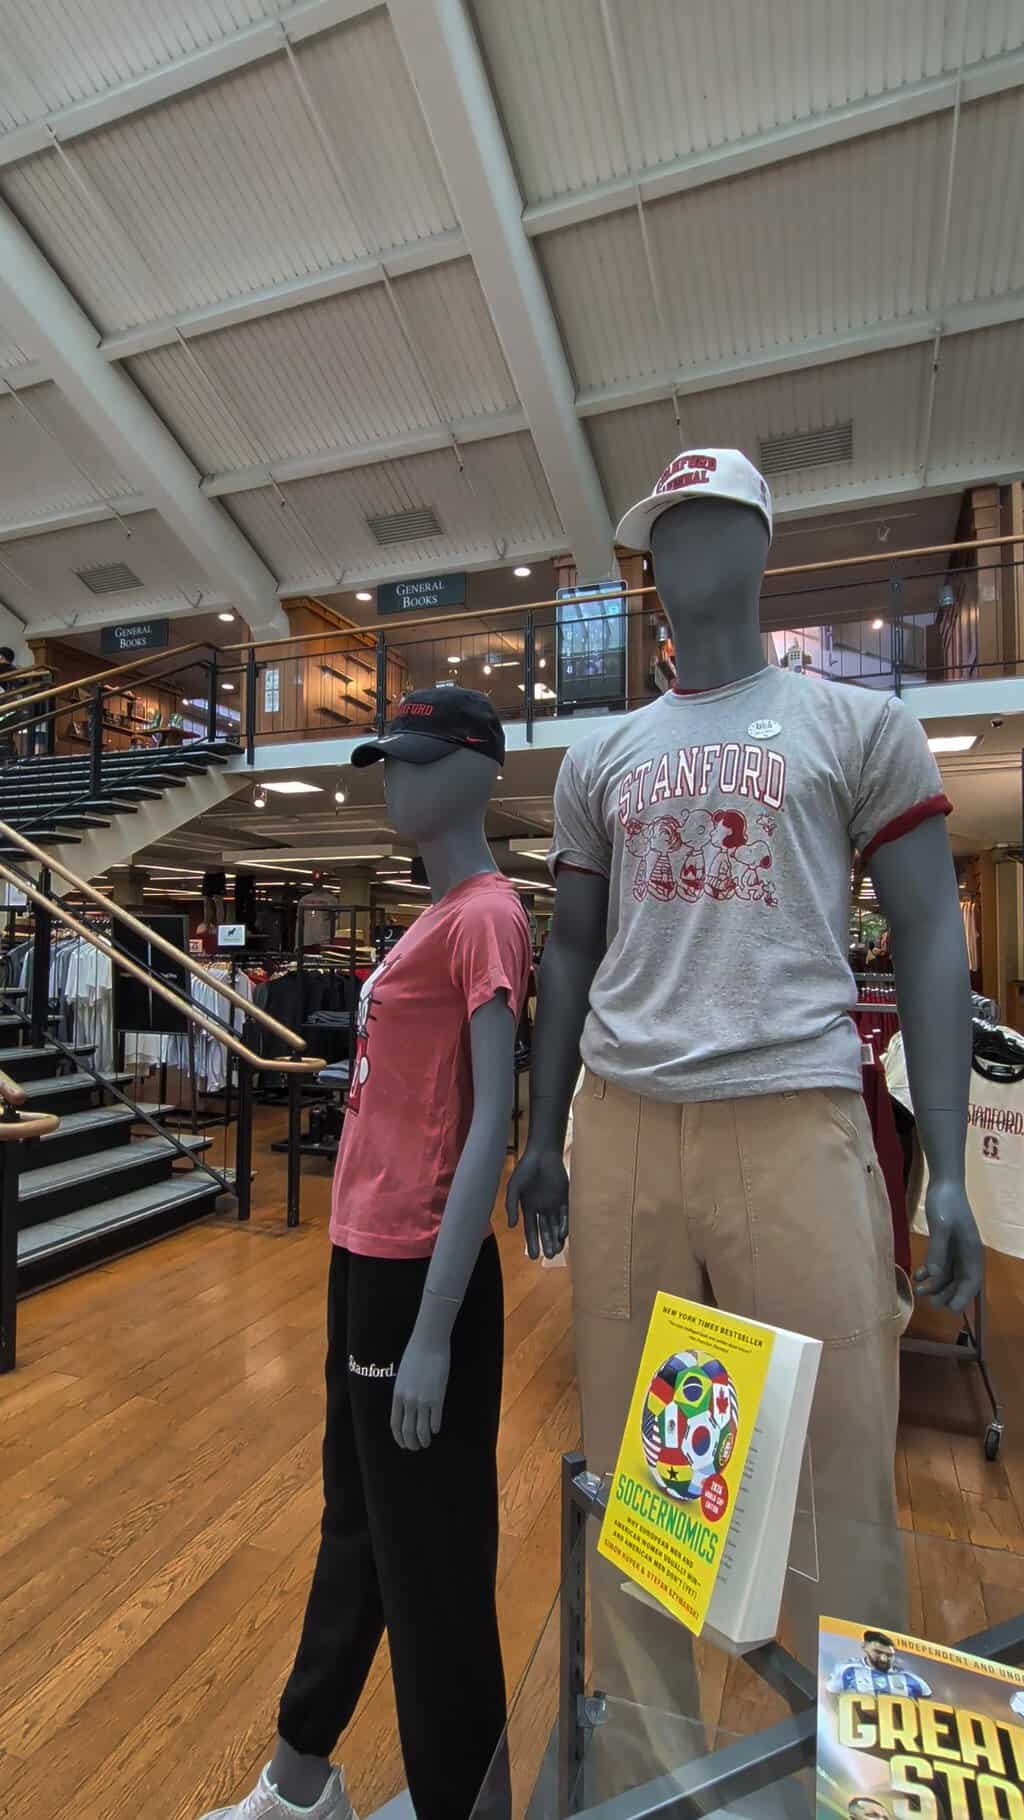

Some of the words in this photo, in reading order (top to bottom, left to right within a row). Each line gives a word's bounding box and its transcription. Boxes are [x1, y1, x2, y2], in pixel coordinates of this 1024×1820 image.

[396, 580, 445, 596] GENERAL
[403, 595, 439, 608] BOOKS
[115, 625, 152, 638] GENERAL
[120, 638, 146, 648] BOOKS
[618, 742, 786, 827] STANFORD
[662, 1305, 677, 1316] NEW
[679, 1311, 697, 1323] YORK
[698, 1318, 719, 1332] TIMES
[720, 1327, 763, 1347] BESTSELLER
[616, 1474, 719, 1565] SOCCERNOMICS
[613, 1530, 625, 1542] AND
[624, 1538, 653, 1562] AMERICAN
[653, 1559, 666, 1573] MEN
[614, 1519, 641, 1542] AMERICAN
[641, 1538, 663, 1558] WOMEN
[663, 1553, 687, 1577] USUALLY
[640, 1523, 669, 1550] EUROPEAN
[647, 1569, 668, 1593] STEFAN
[896, 1637, 969, 1667] INDEPENDENT
[974, 1660, 995, 1675] AND
